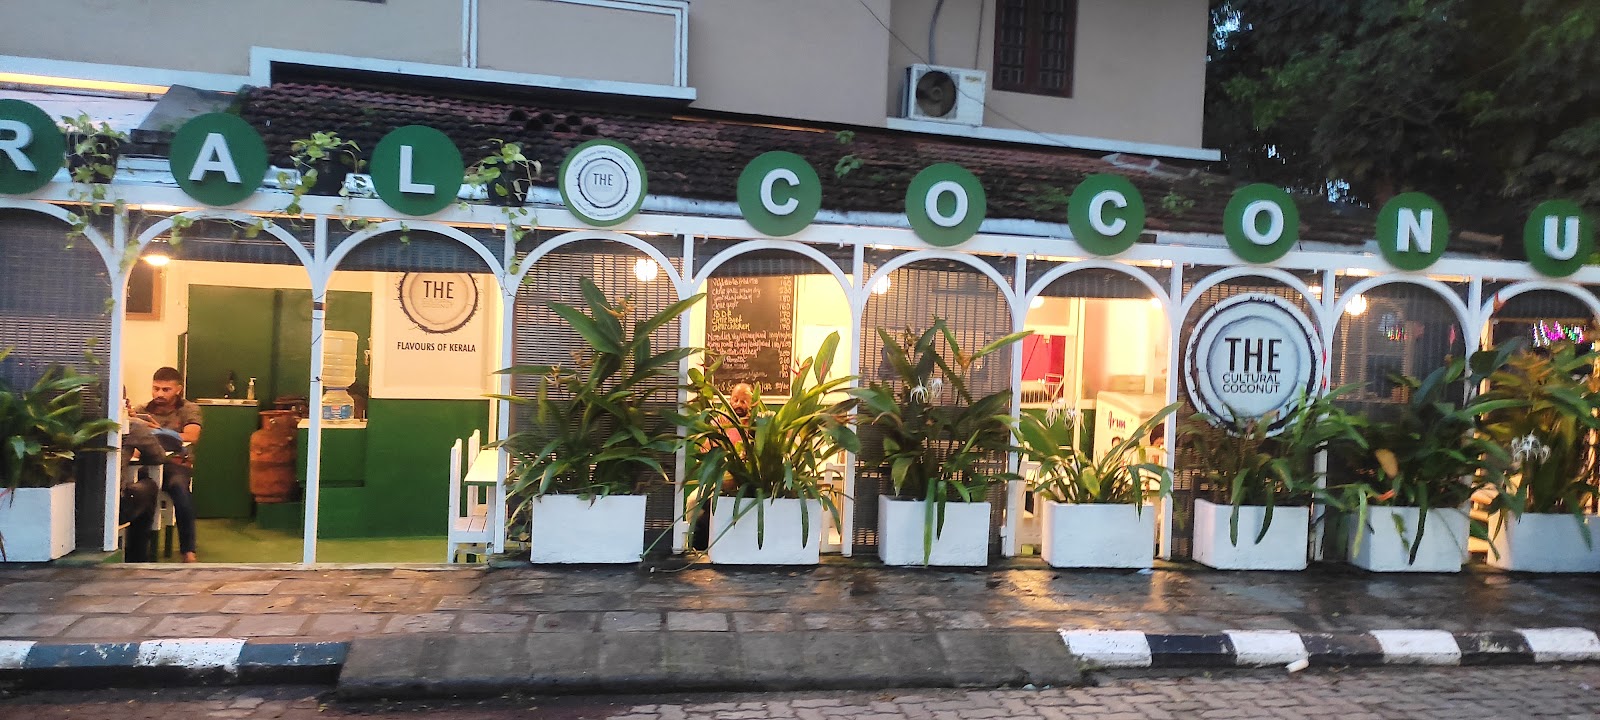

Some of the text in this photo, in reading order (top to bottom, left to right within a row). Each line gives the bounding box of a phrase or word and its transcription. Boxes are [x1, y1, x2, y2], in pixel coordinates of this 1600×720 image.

[593, 173, 614, 187] THE
[423, 280, 455, 299] THE
[397, 341, 476, 352] FLAVOURS OF KERALA
[1224, 337, 1282, 373] THE
[1222, 373, 1279, 384] CULTURAL
[1222, 384, 1280, 395] COCONUT
